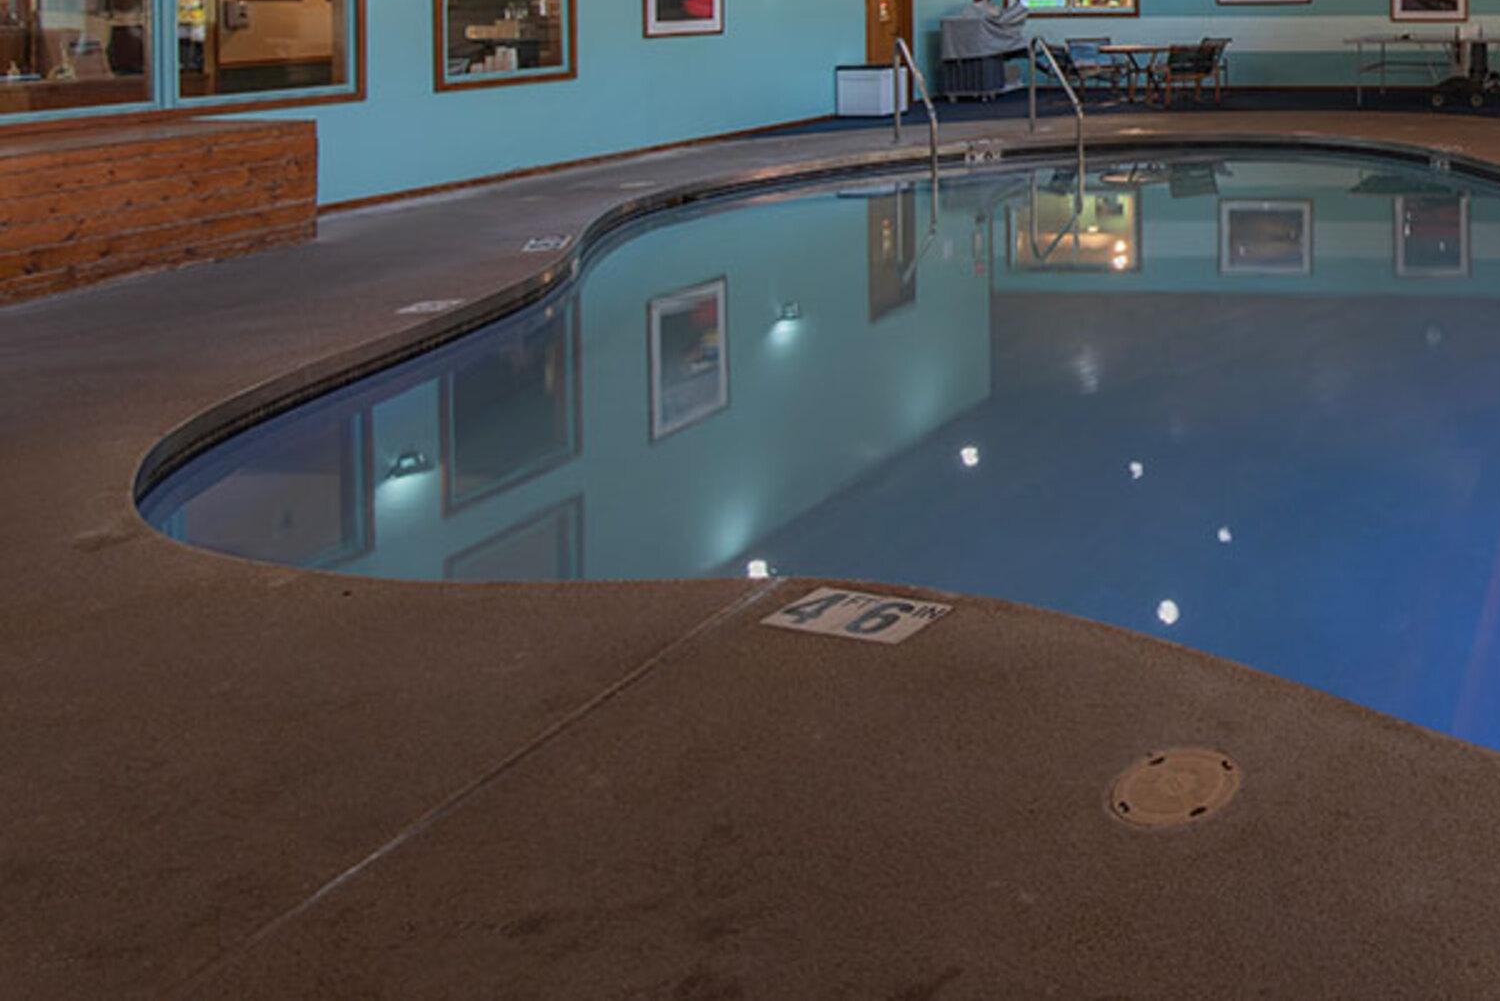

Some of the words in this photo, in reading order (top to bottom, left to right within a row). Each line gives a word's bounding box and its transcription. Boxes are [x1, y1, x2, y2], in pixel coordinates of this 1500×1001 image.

[781, 593, 849, 624] 4
[844, 602, 914, 635] 6
[912, 605, 946, 621] IN
